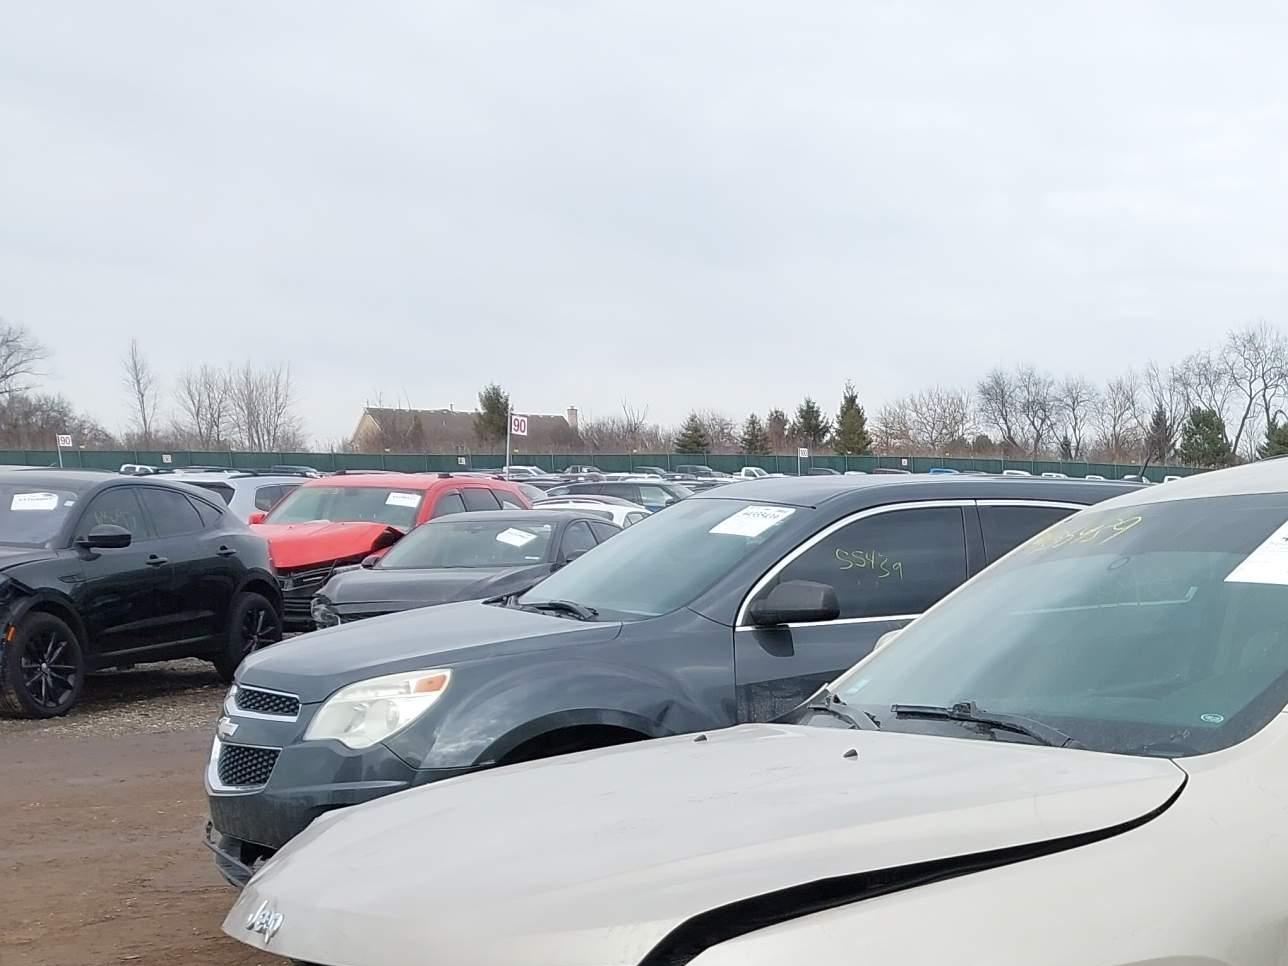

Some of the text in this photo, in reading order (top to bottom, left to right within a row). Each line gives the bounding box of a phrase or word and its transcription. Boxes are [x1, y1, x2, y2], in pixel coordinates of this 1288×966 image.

[512, 417, 526, 433] 90
[60, 436, 71, 445] 90
[247, 900, 284, 944] Jeep
